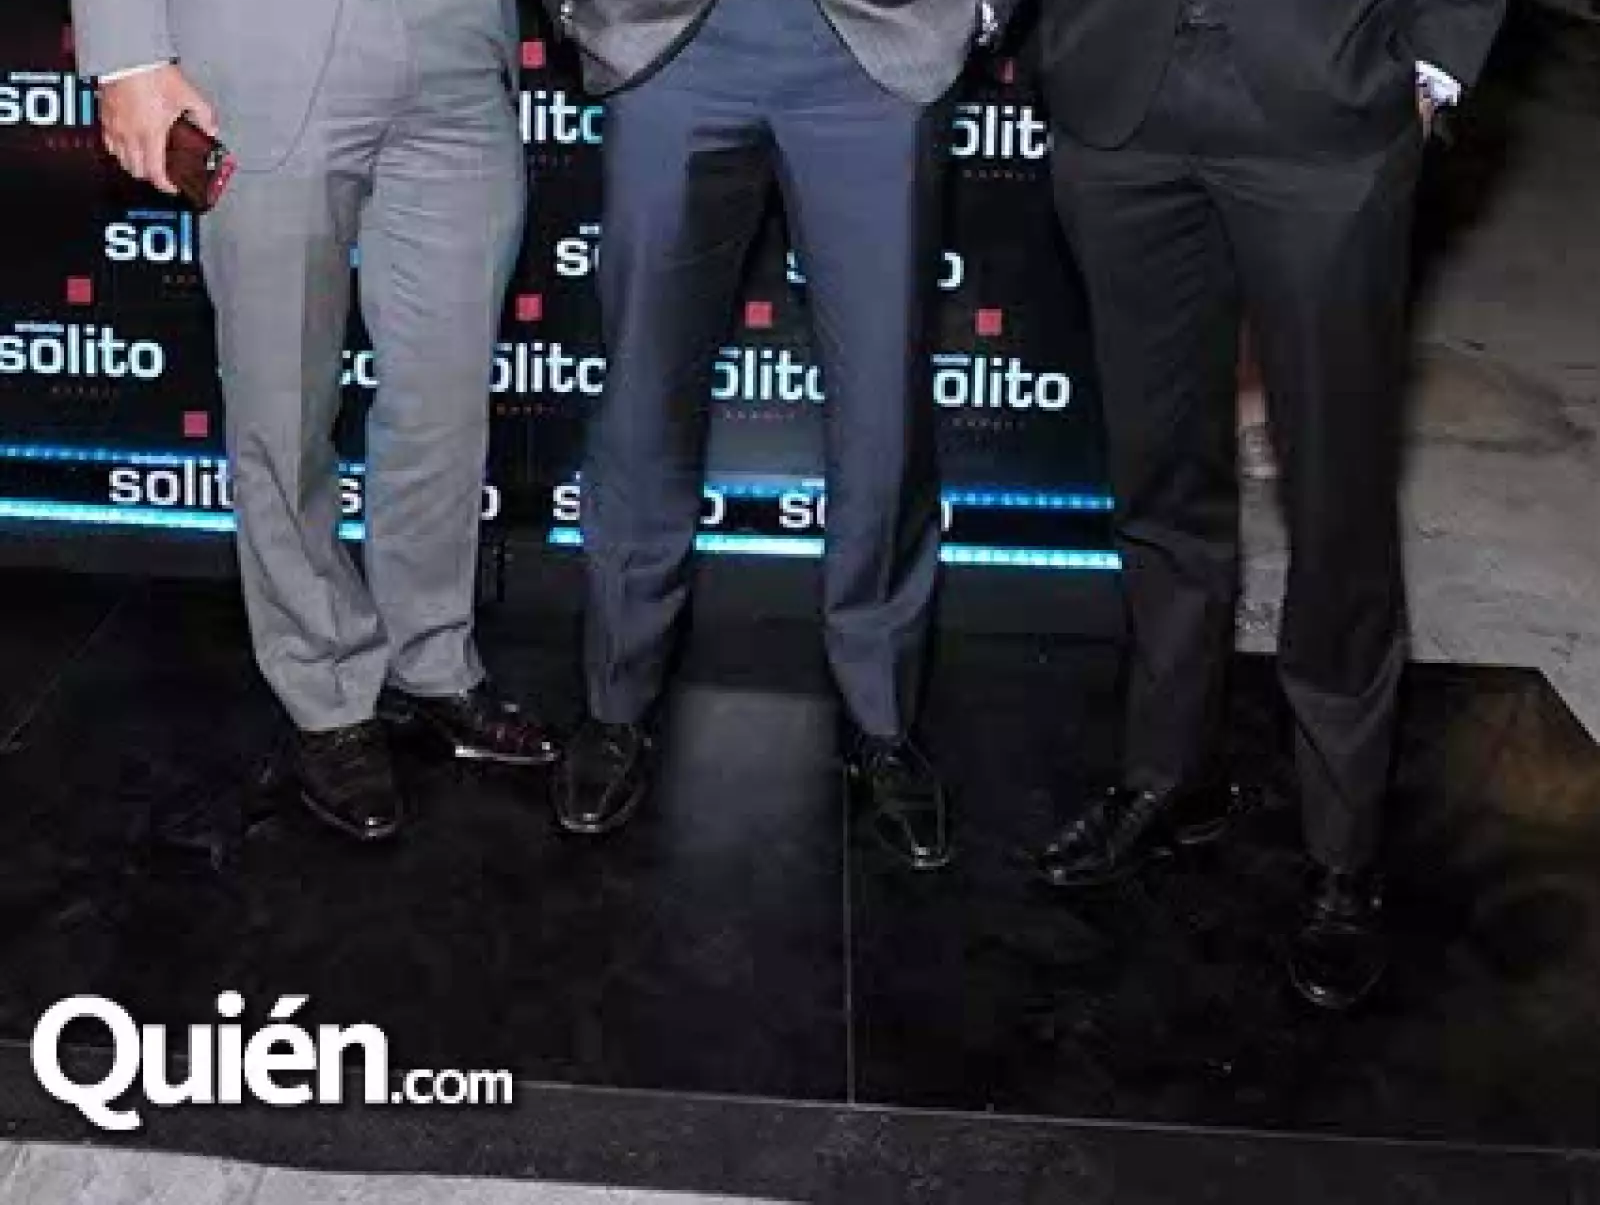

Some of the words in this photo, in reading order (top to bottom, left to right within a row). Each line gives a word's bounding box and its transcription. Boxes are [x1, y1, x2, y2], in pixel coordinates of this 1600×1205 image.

[0, 324, 163, 379] solito
[490, 343, 607, 396] olito
[711, 348, 825, 402] olito
[933, 356, 1071, 410] olito
[109, 460, 233, 508] solit
